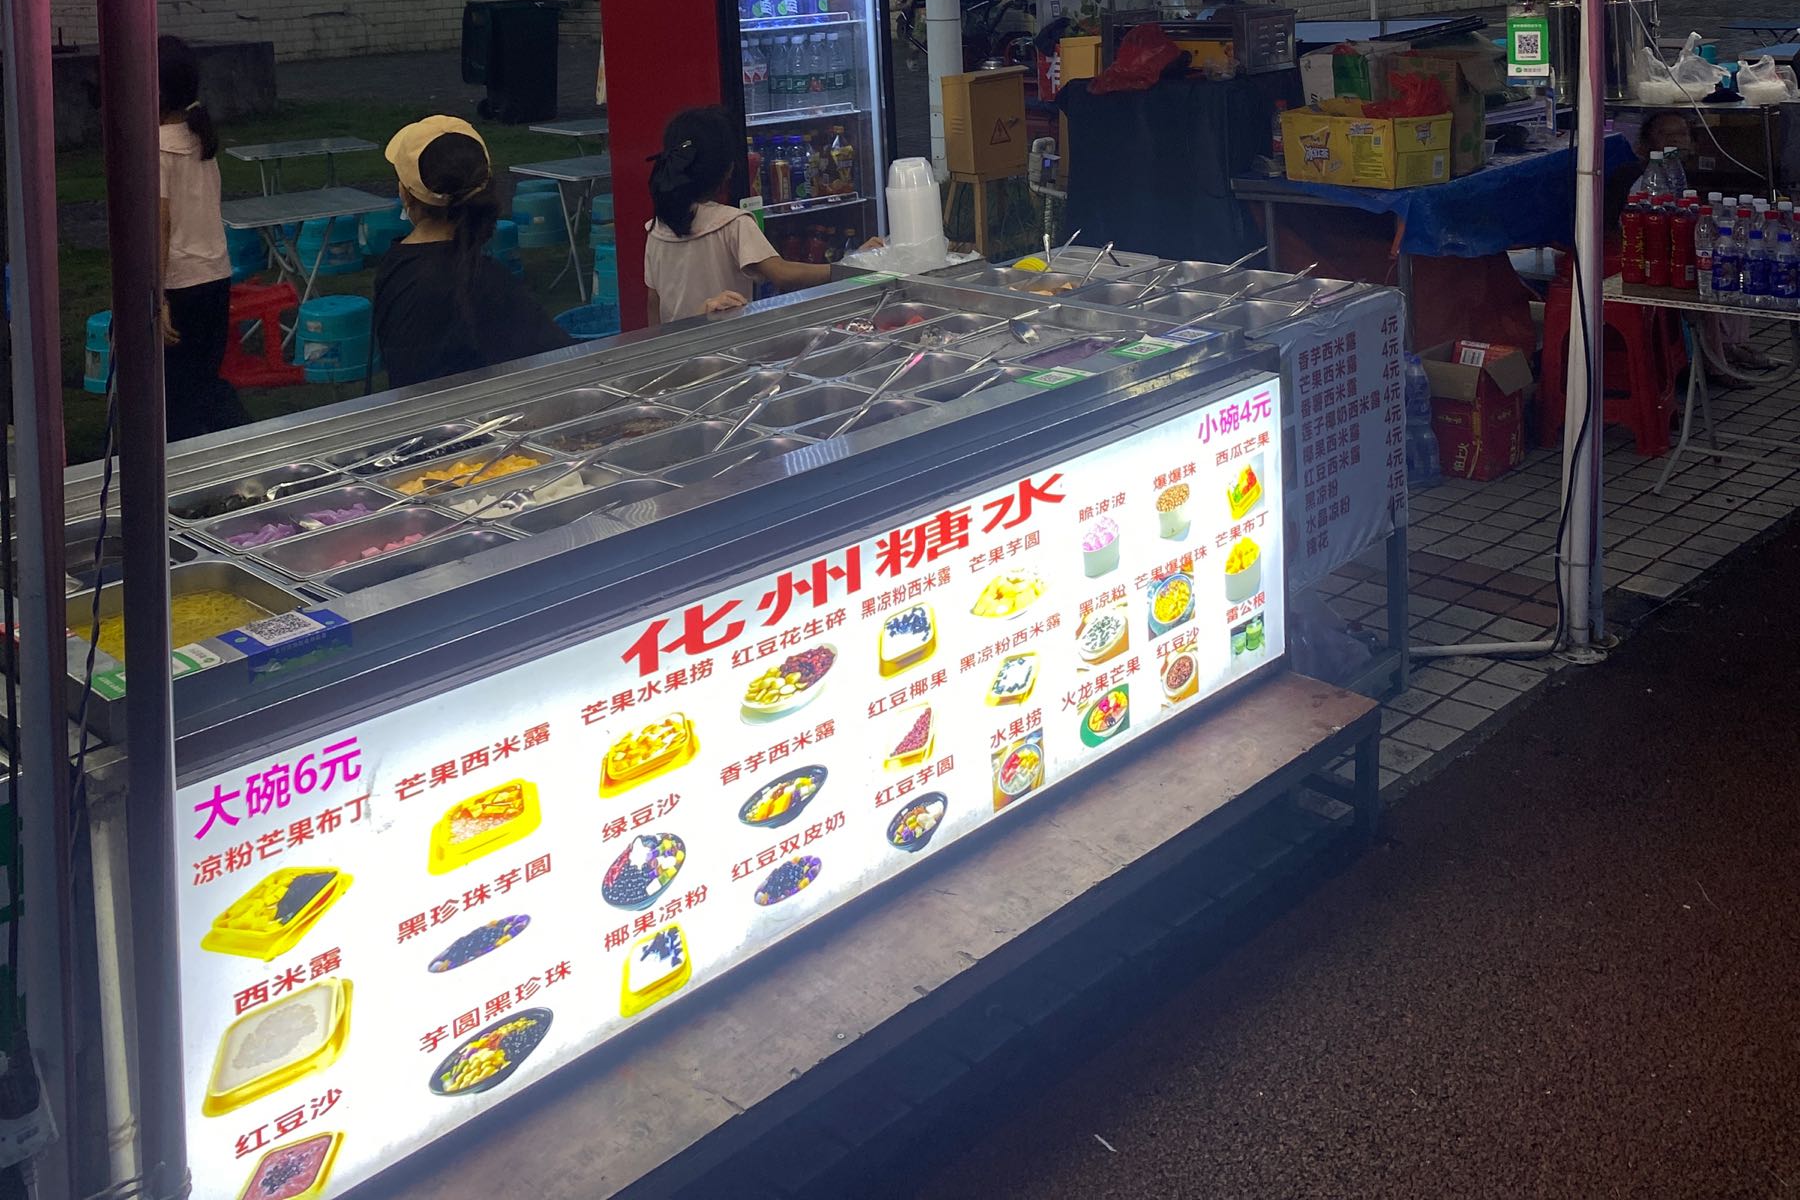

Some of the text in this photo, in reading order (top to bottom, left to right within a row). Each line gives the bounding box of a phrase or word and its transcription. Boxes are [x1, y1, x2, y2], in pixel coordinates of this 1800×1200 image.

[1299, 315, 1398, 371] 香芋西米露 4元
[1299, 337, 1399, 395] 芒果西米露 4元
[1382, 360, 1400, 381] 4元
[1384, 382, 1401, 404] 4元
[1198, 390, 1271, 444] 小碗4元
[1385, 404, 1402, 424] 4元
[1216, 431, 1270, 466] 西瓜芒果
[1304, 426, 1402, 488] 红豆西米露 4元
[1386, 448, 1403, 469] 4元
[1078, 492, 1126, 523] 脆波波
[1387, 470, 1404, 491] 4元
[969, 530, 1040, 573] 芒果芋圆
[1215, 511, 1269, 548] 芒果布丁
[621, 473, 1067, 677] 化州糖水
[861, 566, 951, 620] 黑凉粉西米露
[1079, 584, 1126, 617] 黑凉粉
[1226, 592, 1265, 624] 雷公根
[731, 608, 847, 669] 红豆花生碎
[959, 612, 1061, 673] 黑凉粉西米露
[1156, 626, 1199, 659] 红豆沙
[581, 658, 713, 726] 芒果水果捞
[867, 668, 948, 719] 红豆椰果
[1061, 656, 1141, 711] 火龙果芒果
[720, 719, 835, 786] 香芋西米露
[990, 708, 1042, 749] 水果捞
[194, 736, 362, 841] 大碗6元
[395, 722, 550, 801] 芒果西米露
[875, 754, 954, 808] 红豆芋圆
[193, 794, 370, 886] 凉粉芒果布丁
[602, 793, 681, 843] 绿豆沙
[730, 811, 845, 882] 红豆双皮奶
[396, 853, 551, 944] 黑珍珠芋圆
[604, 884, 708, 952] 椰果凉粉
[233, 947, 342, 1015] 西米露
[419, 961, 572, 1053] 芋圆黑珍珠
[235, 1088, 343, 1160] 红豆沙
